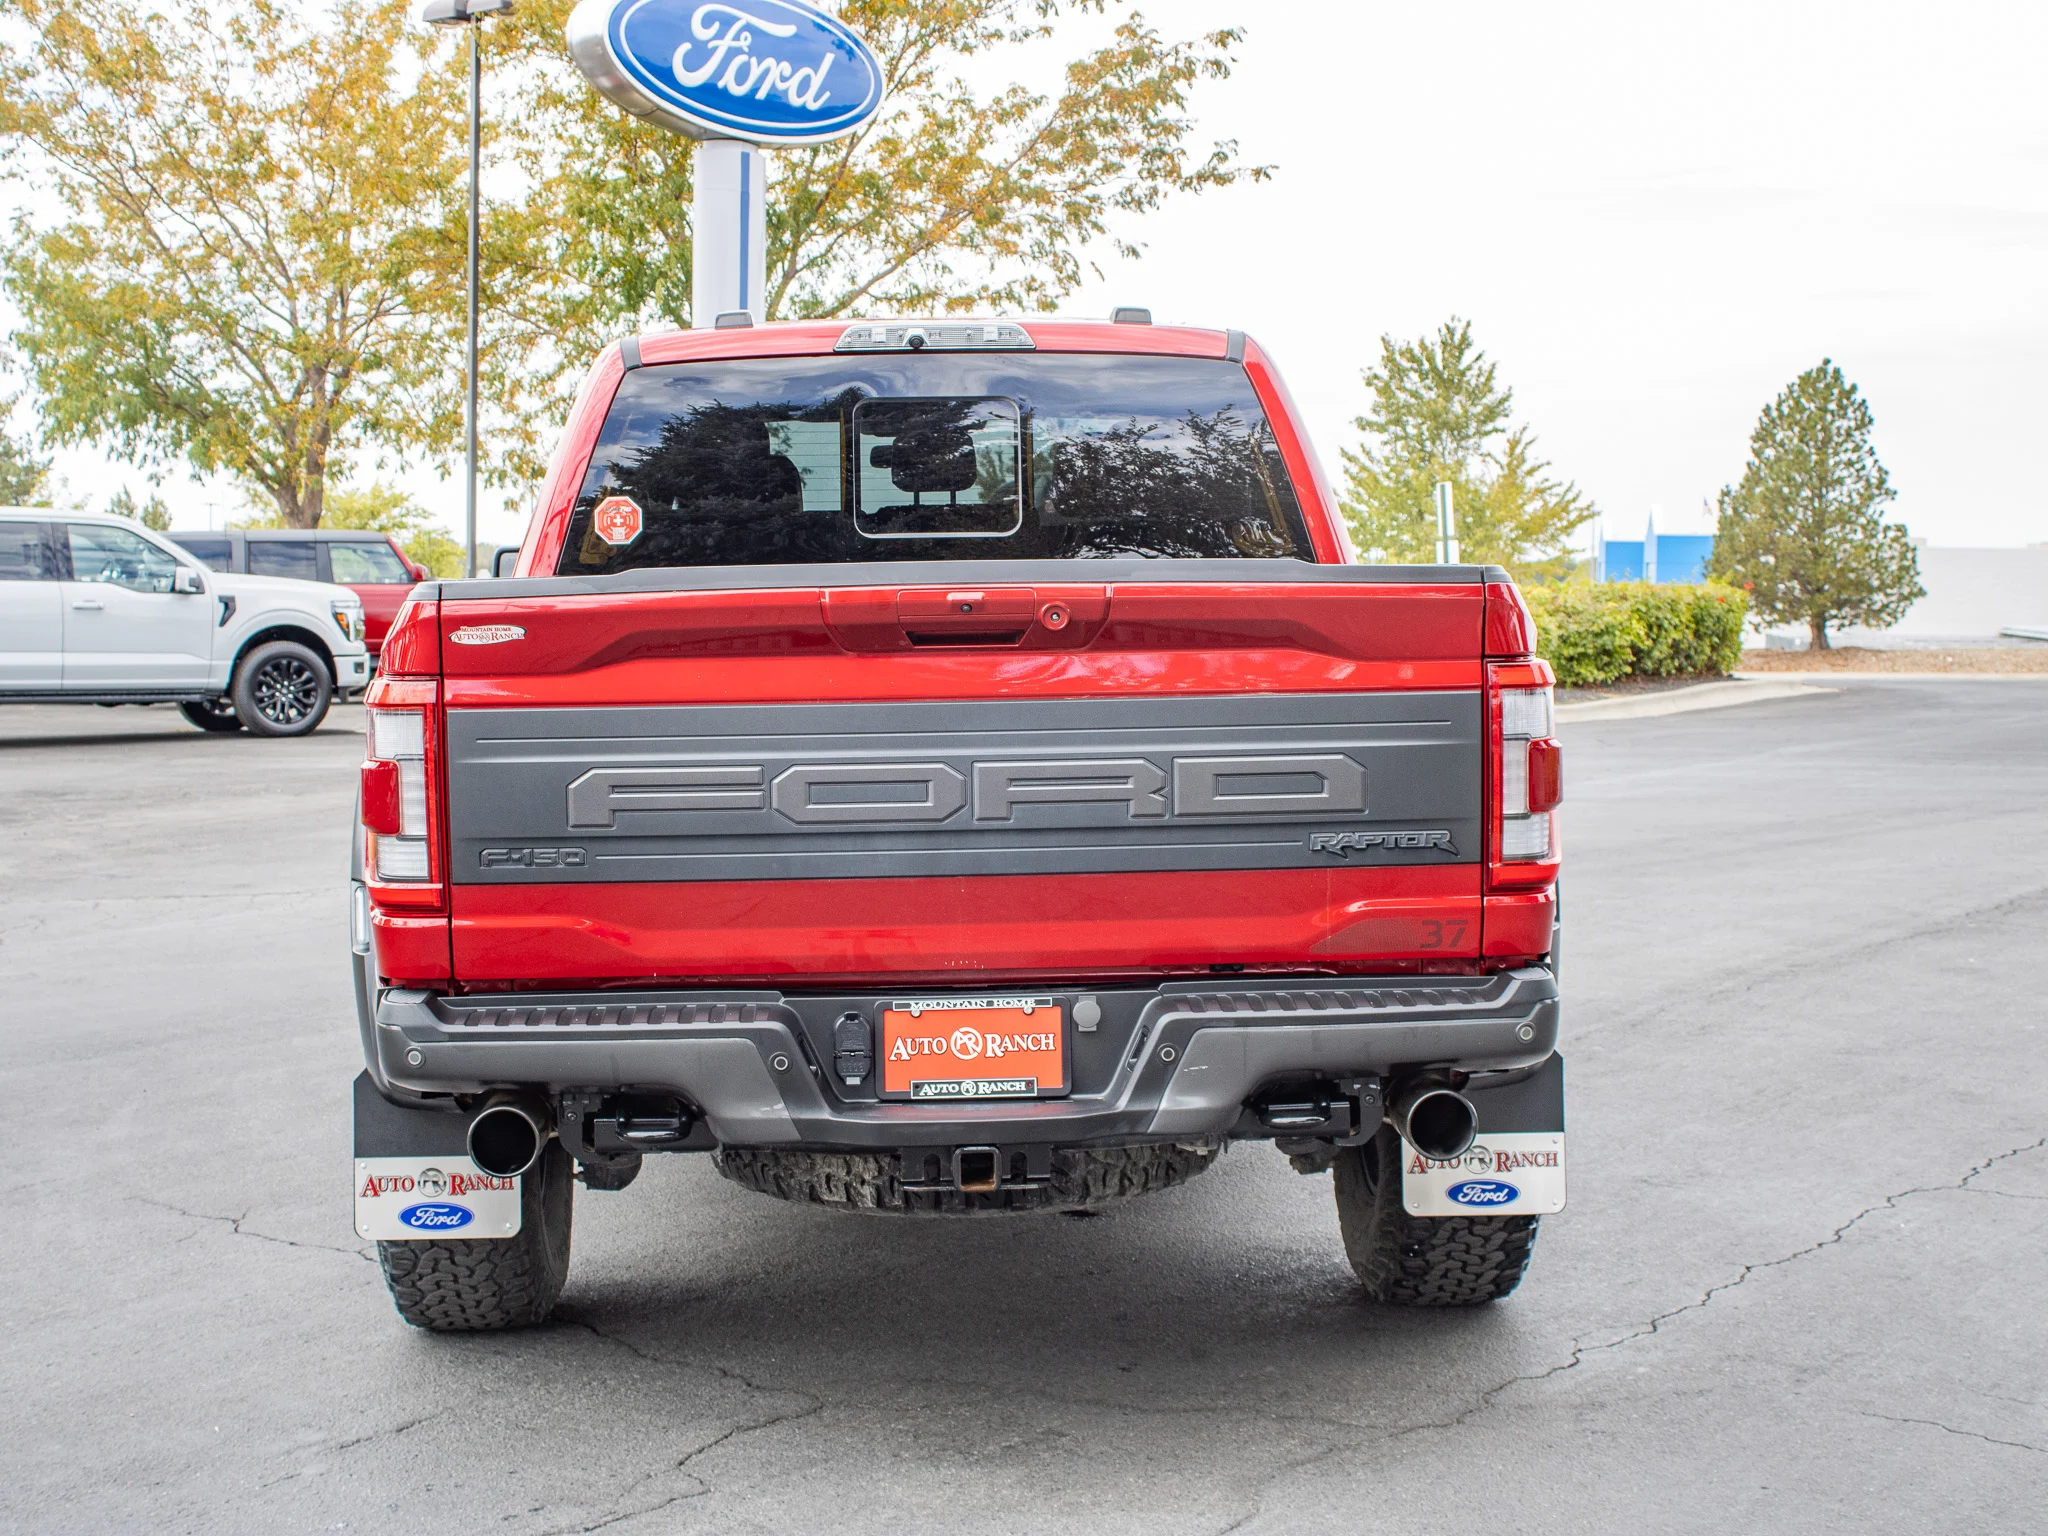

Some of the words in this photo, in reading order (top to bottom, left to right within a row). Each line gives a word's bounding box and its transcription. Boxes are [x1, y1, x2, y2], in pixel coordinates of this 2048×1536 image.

[672, 3, 835, 110] Ford
[454, 632, 479, 641] AUTO
[566, 752, 1368, 829] FORD
[1309, 829, 1460, 860] RAPTOR
[480, 847, 587, 867] F-150
[1420, 919, 1468, 949] 37
[910, 999, 987, 1009] MOUNTAIN
[994, 998, 1036, 1008] HOME
[888, 1036, 948, 1061] AUTO
[984, 1033, 1056, 1058] RANCH
[919, 1083, 959, 1096] AUTO
[978, 1081, 1027, 1094] RANCH
[1493, 1151, 1558, 1173] RANCH
[360, 1174, 415, 1197] AUTO
[448, 1173, 514, 1196] RANCH
[1457, 1183, 1508, 1203] Ford
[410, 1207, 462, 1226] Ford
